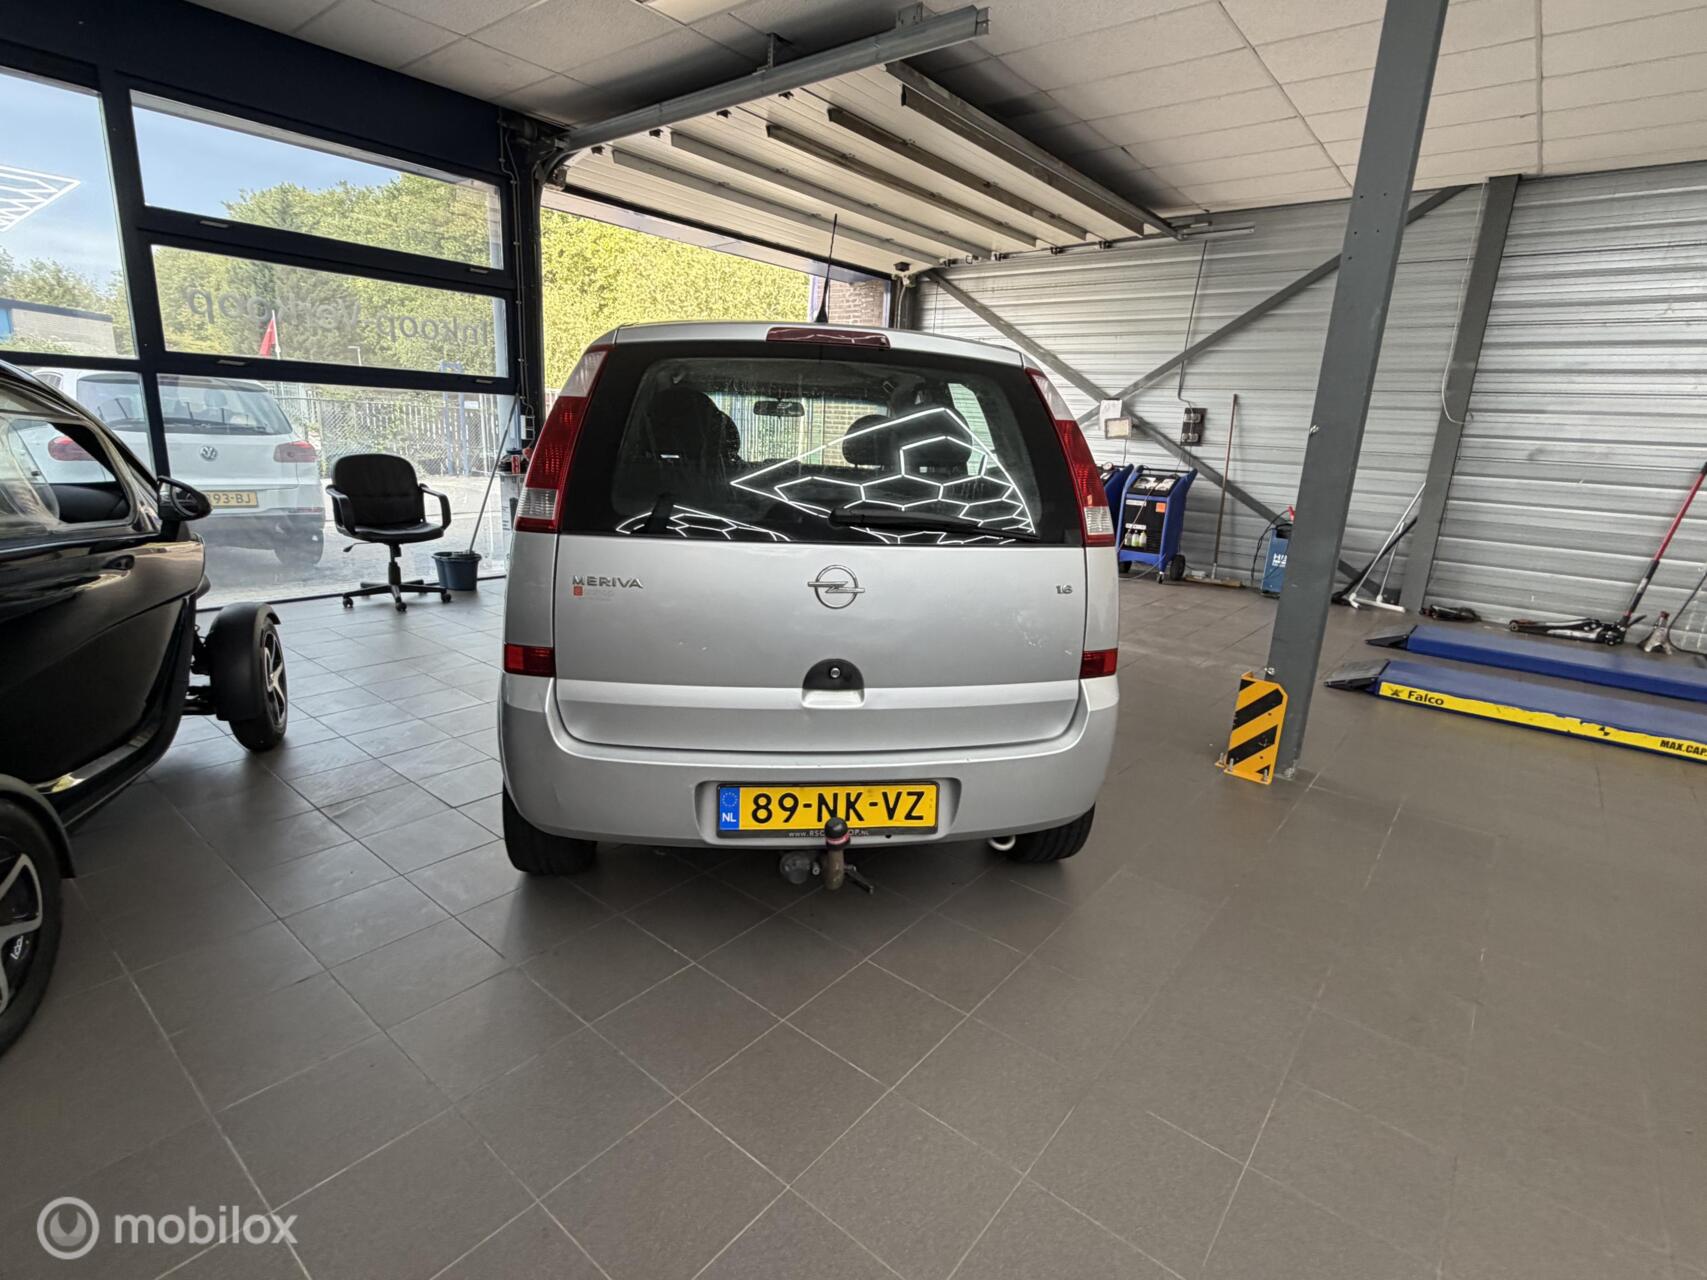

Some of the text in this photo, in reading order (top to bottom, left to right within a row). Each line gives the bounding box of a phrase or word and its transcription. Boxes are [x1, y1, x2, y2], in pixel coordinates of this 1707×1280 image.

[572, 575, 643, 589] MERIVA
[1407, 690, 1445, 706] Falco
[751, 791, 925, 824] 89-NK-VZ
[721, 812, 737, 823] NL
